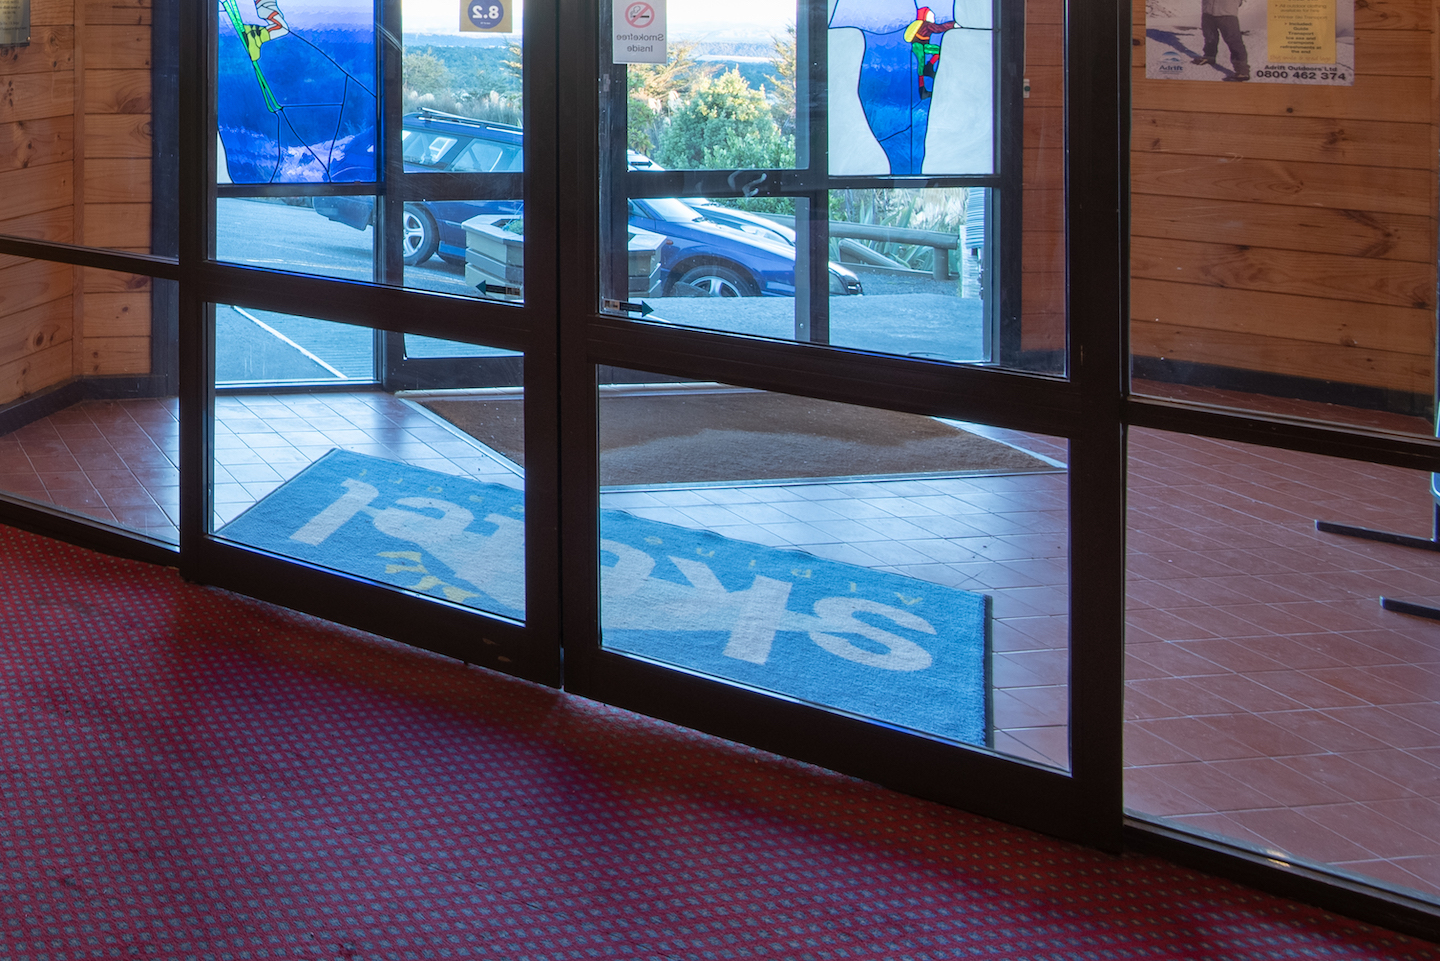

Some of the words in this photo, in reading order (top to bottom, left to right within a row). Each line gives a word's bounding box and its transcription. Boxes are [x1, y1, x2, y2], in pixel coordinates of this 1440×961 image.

[1158, 64, 1184, 72] Adrift
[1256, 69, 1289, 79] 0800
[1292, 70, 1317, 80] 462
[1320, 71, 1346, 81] 374
